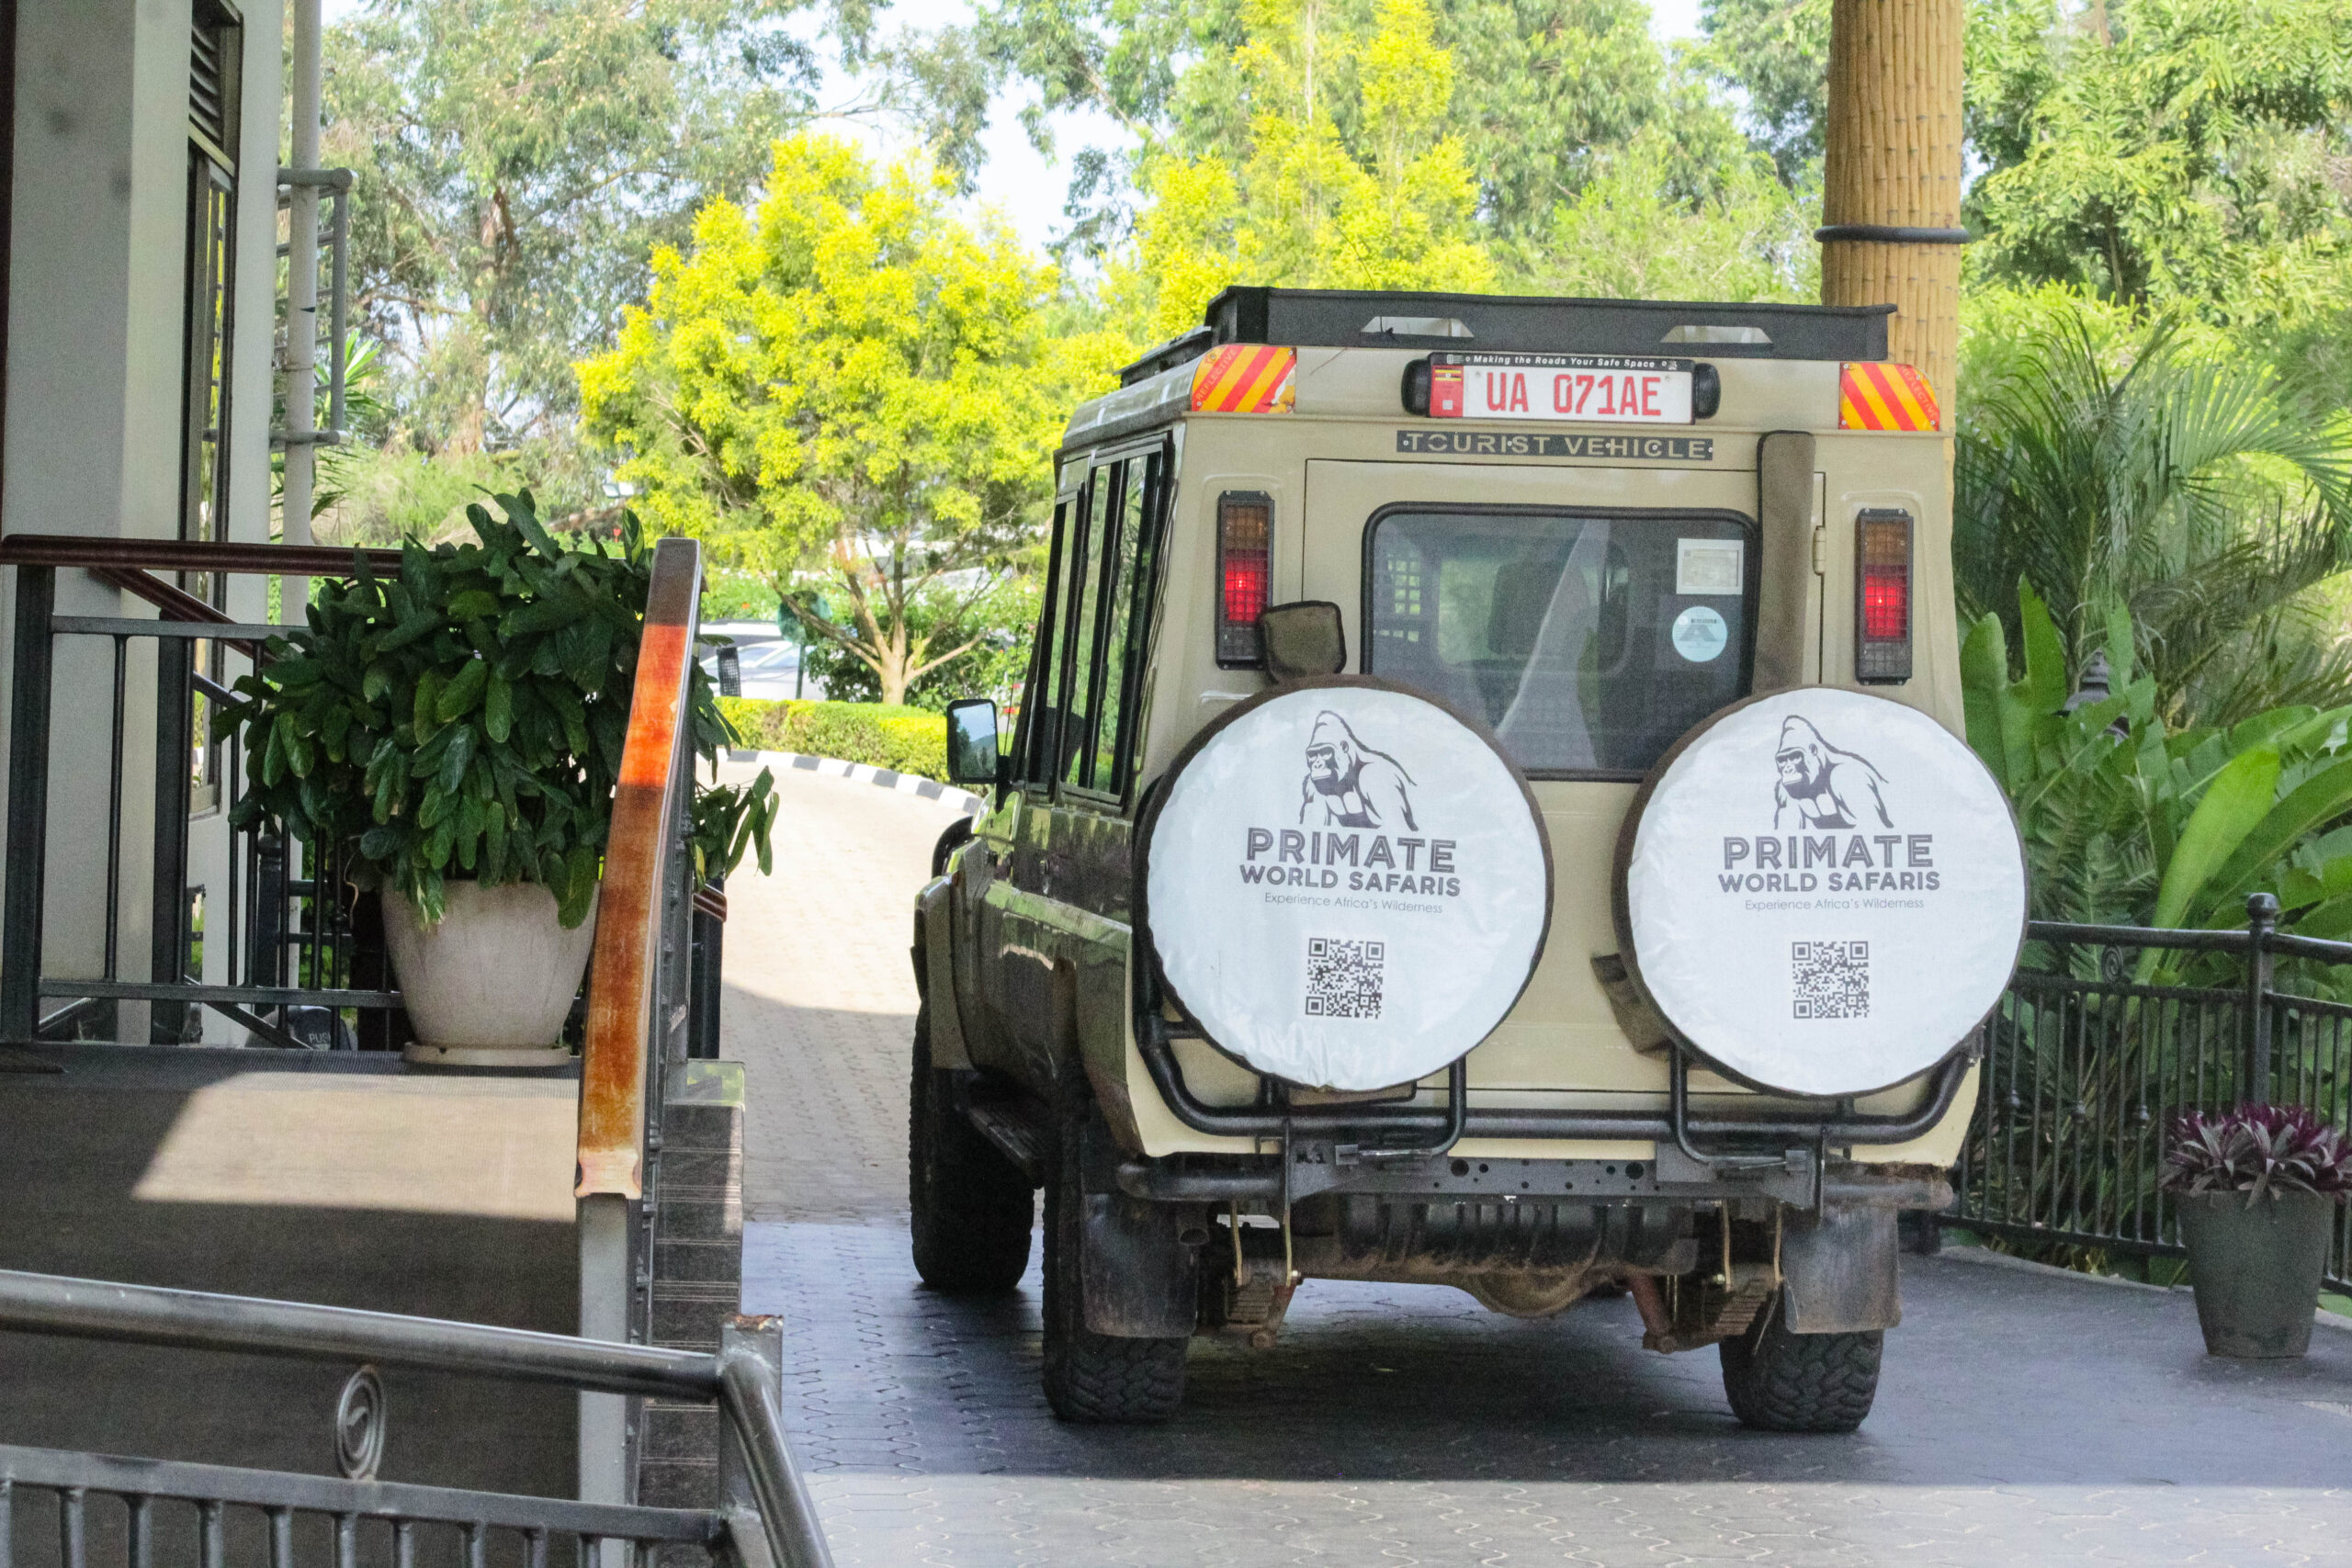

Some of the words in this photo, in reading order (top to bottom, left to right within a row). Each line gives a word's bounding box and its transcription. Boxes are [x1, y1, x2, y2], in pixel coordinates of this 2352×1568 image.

[1196, 349, 1238, 401] REFLECTIVE
[1473, 355, 1511, 366] Making
[1514, 355, 1532, 365] the
[1534, 356, 1566, 366] Roads
[1570, 357, 1594, 366] Your
[1597, 357, 1621, 367] Safe
[1623, 359, 1656, 368] Space
[1487, 371, 1529, 412] UA
[1554, 373, 1662, 416] 071AE
[1901, 367, 1938, 419] REFLECTIVE
[1406, 433, 1551, 455] TOURIST
[1564, 436, 1706, 458] VEHICLE
[1246, 827, 1457, 874] PRIMATE
[1723, 833, 1934, 871] PRIMATE
[1239, 863, 1339, 889] WORLD
[1348, 871, 1461, 897] SAFARIS
[1717, 873, 1818, 893] WORLD
[1827, 871, 1940, 892] SAFARIS
[1264, 892, 1331, 906] Experience
[1334, 896, 1378, 910] Africa's
[1381, 898, 1443, 914] Wilderness
[1745, 899, 1812, 912] Experience
[1815, 897, 1860, 909] Africa's
[1862, 897, 1925, 908] Wilderness
